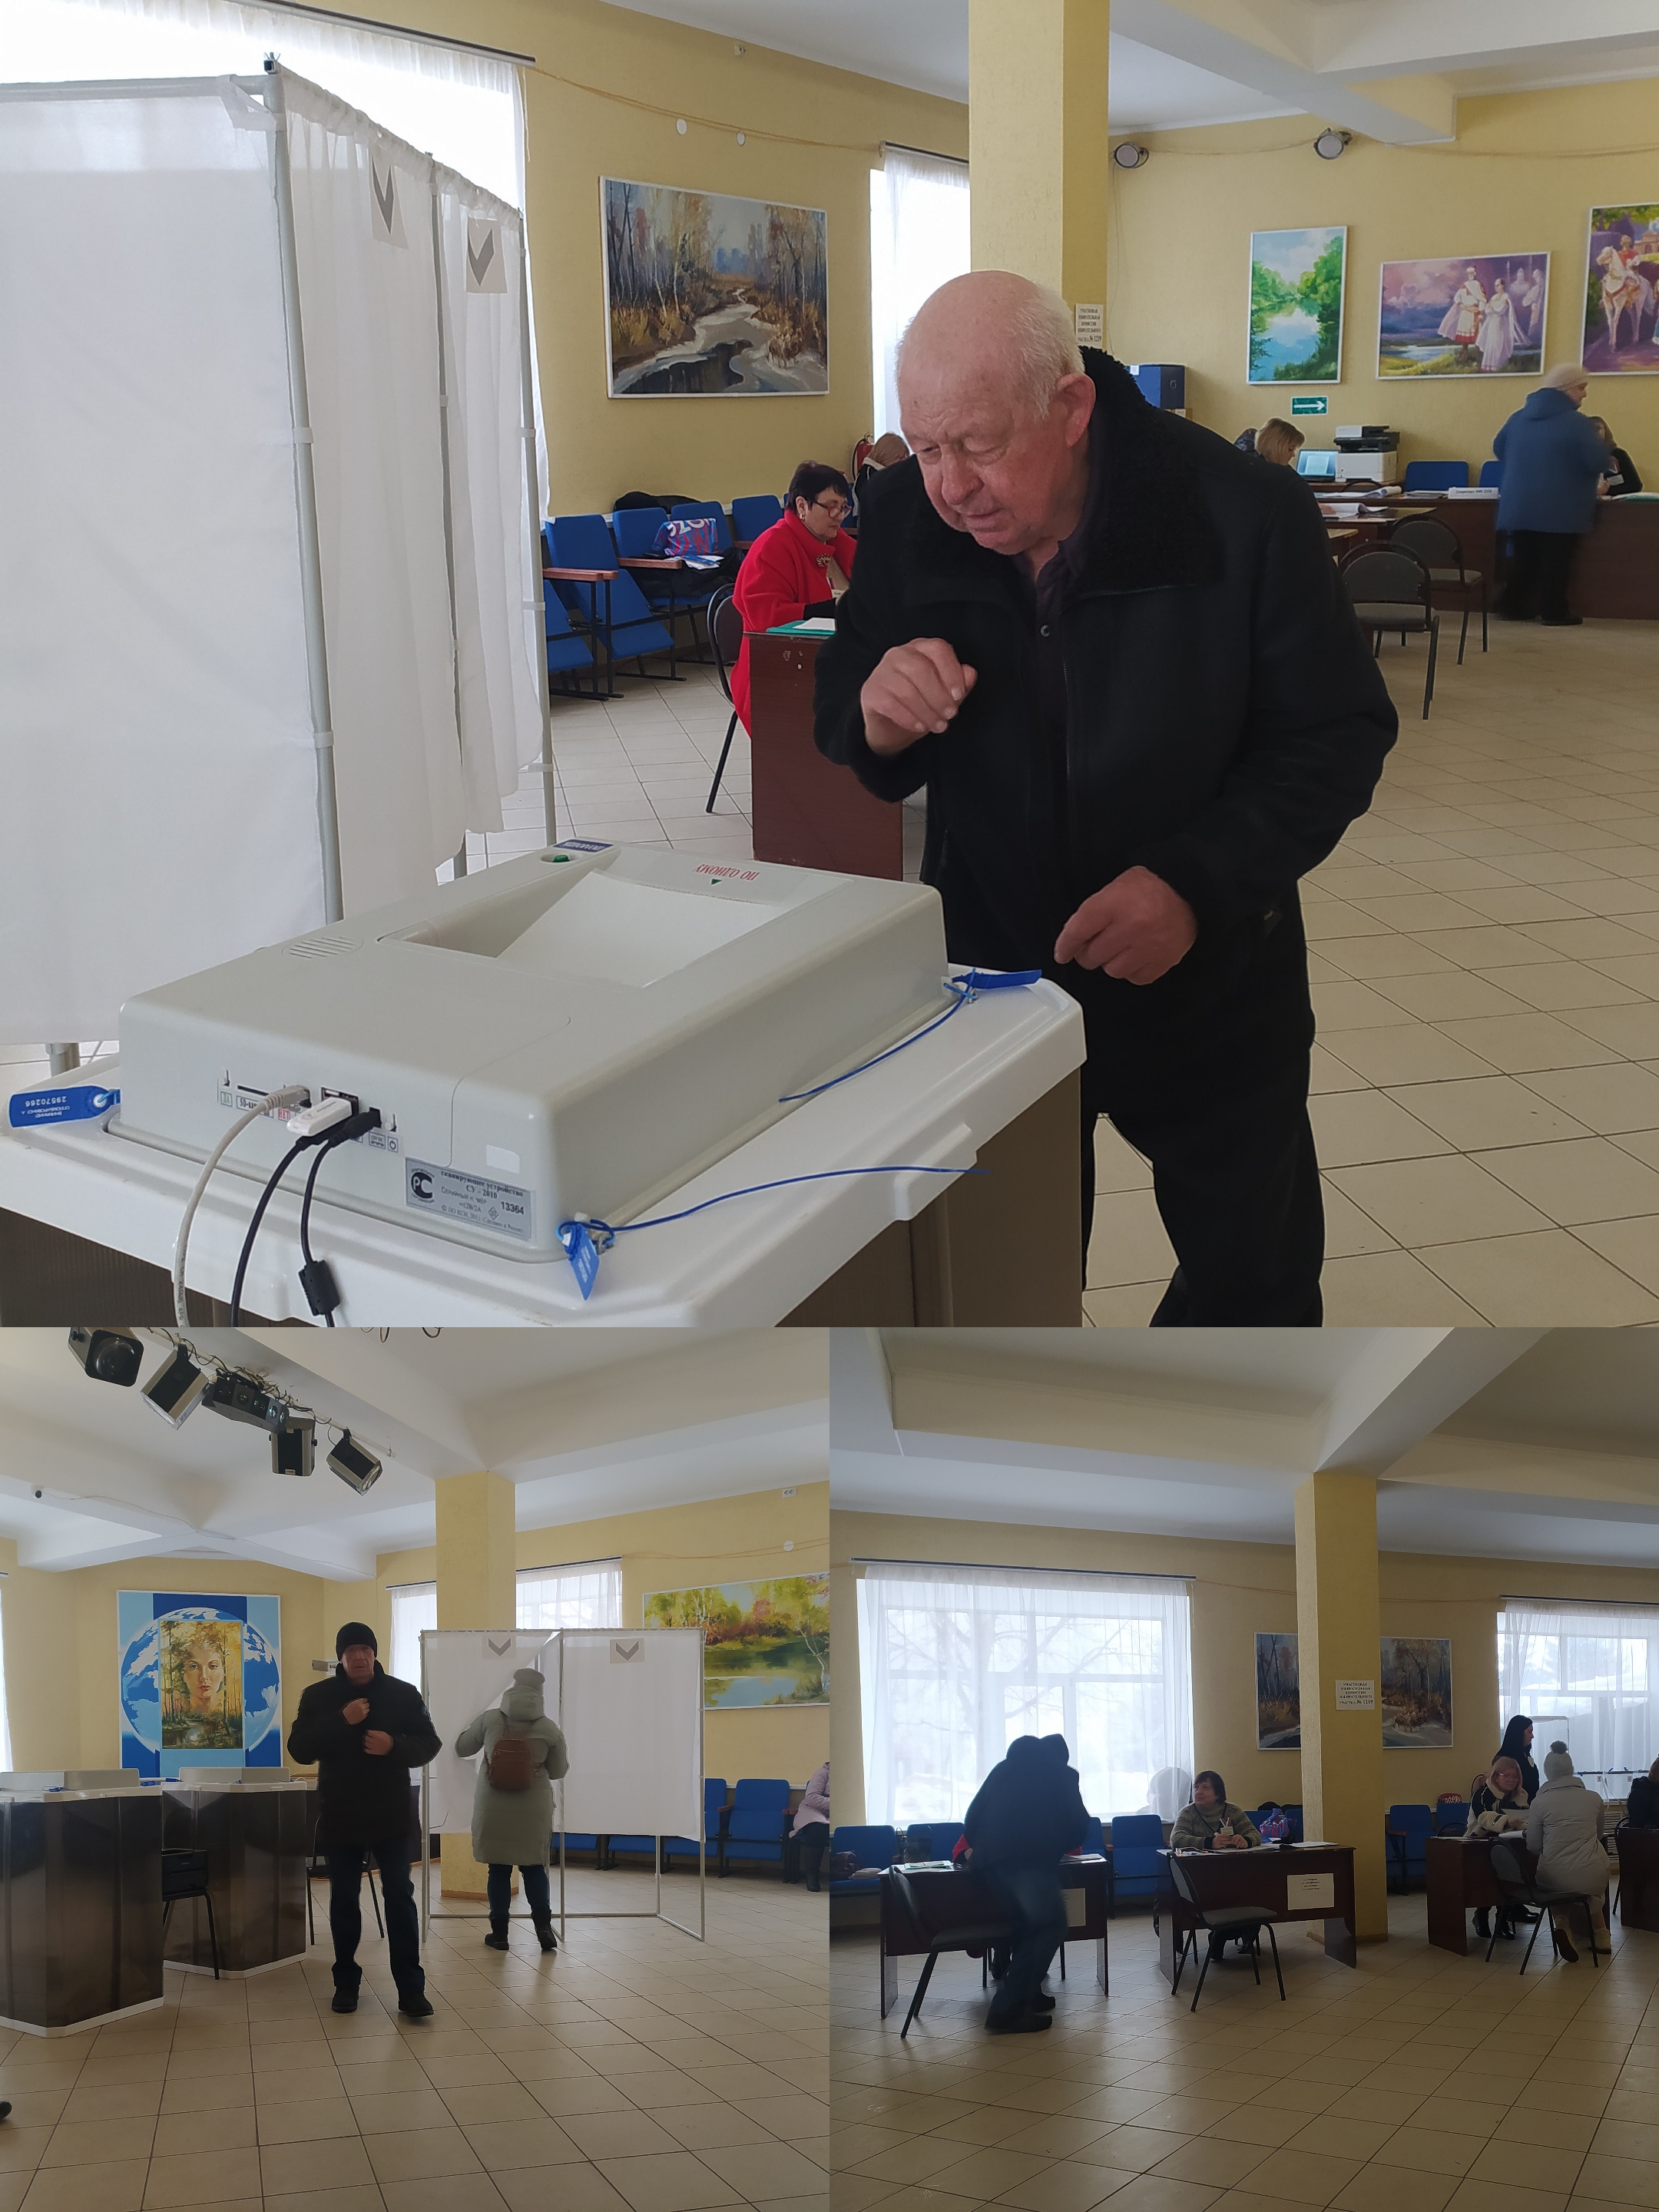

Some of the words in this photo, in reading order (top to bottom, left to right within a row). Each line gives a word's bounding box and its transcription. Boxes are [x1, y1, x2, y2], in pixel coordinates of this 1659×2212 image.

[693, 863, 740, 878] ОДНОМУ
[740, 870, 760, 881] ПО
[440, 1171, 485, 1187] сканирующее
[486, 1183, 524, 1197] устройство
[482, 1190, 498, 1199] 2010
[501, 1201, 525, 1215] 13364
